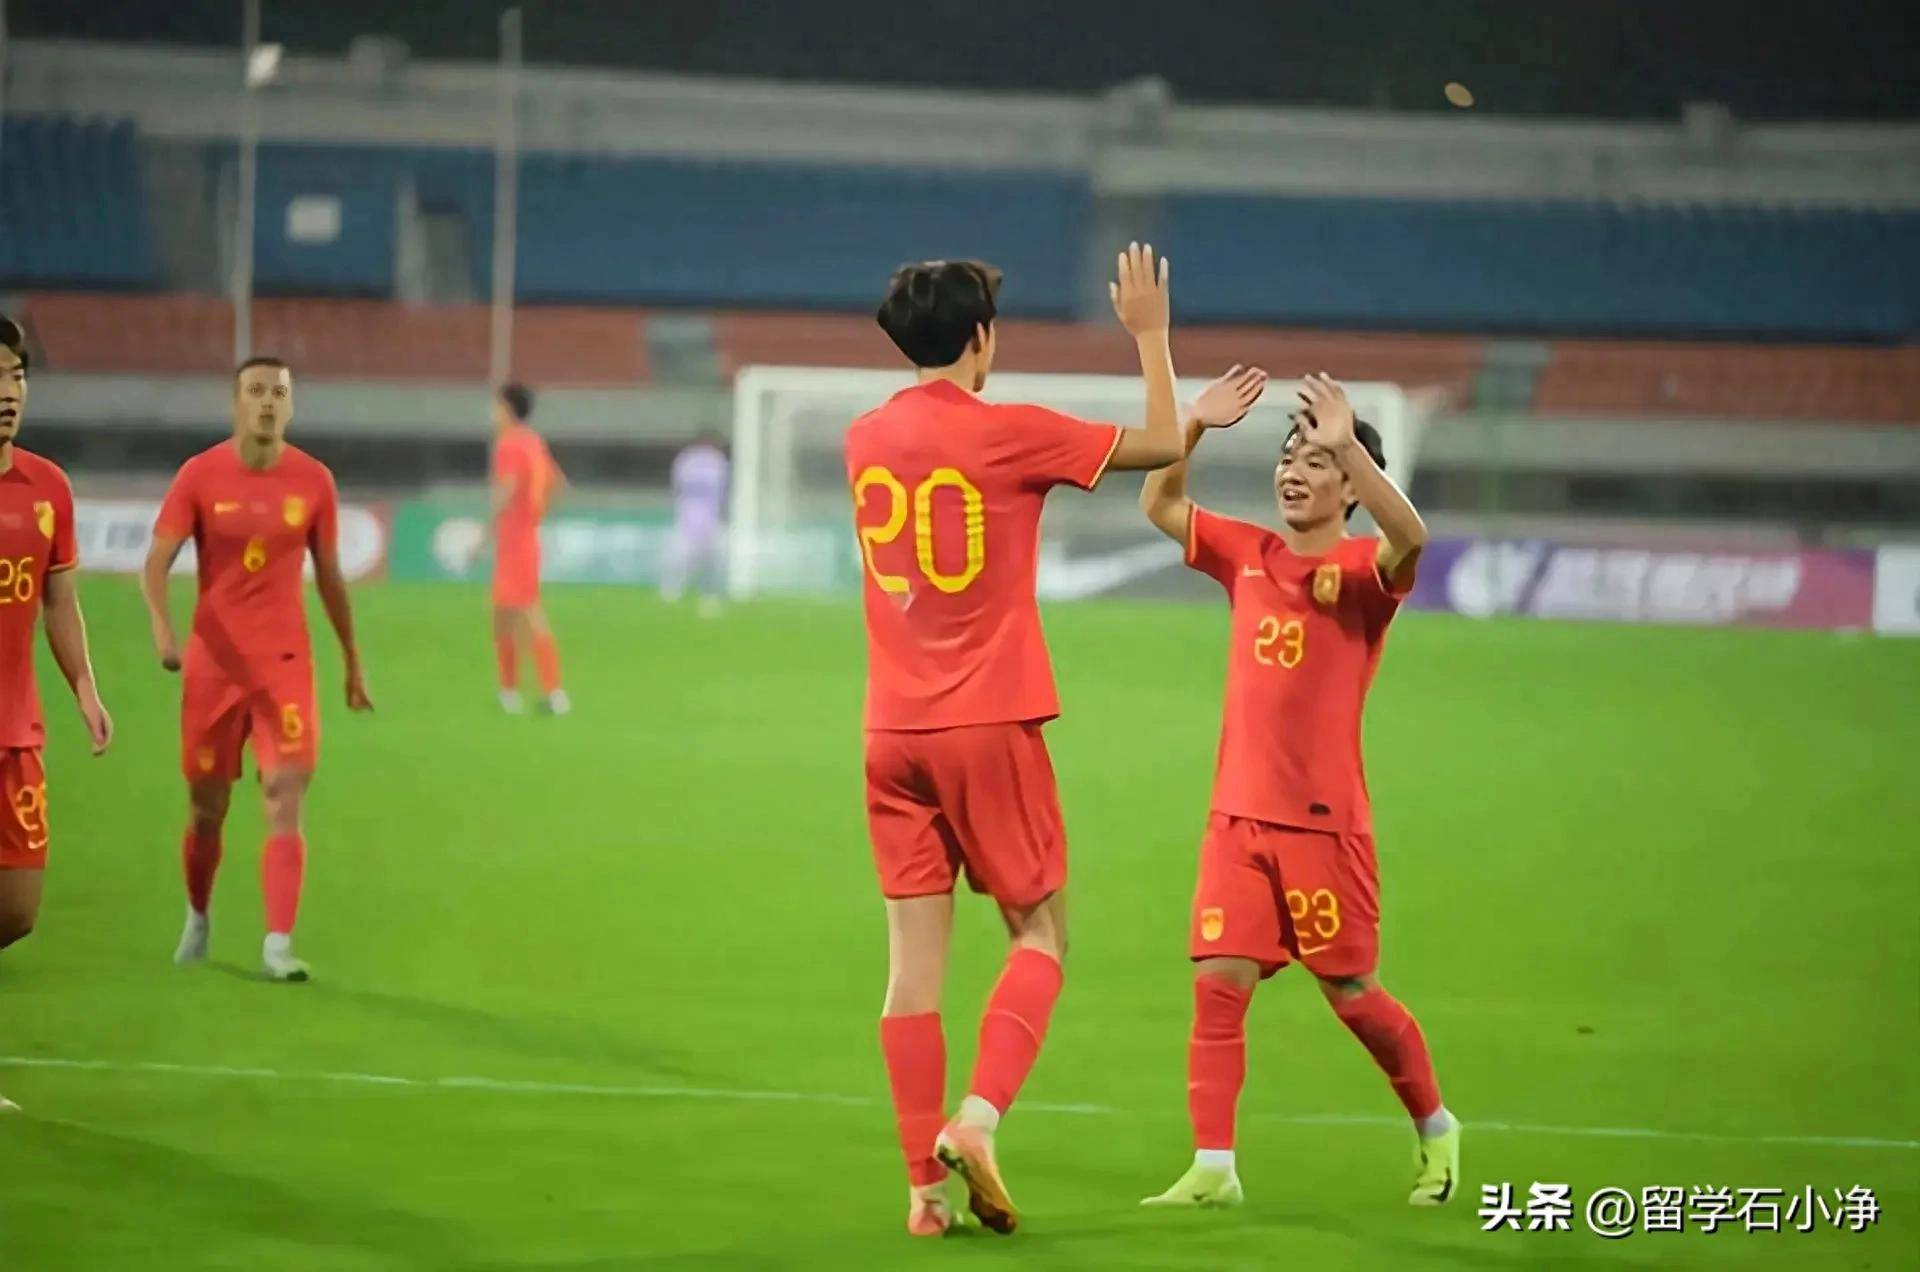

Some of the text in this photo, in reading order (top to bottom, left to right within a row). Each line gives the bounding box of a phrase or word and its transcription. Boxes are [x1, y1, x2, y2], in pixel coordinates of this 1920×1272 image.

[854, 466, 985, 593] 20
[0, 556, 34, 603] 26
[243, 538, 266, 573] 6
[1254, 615, 1304, 669] 23
[1285, 888, 1340, 938] 23
